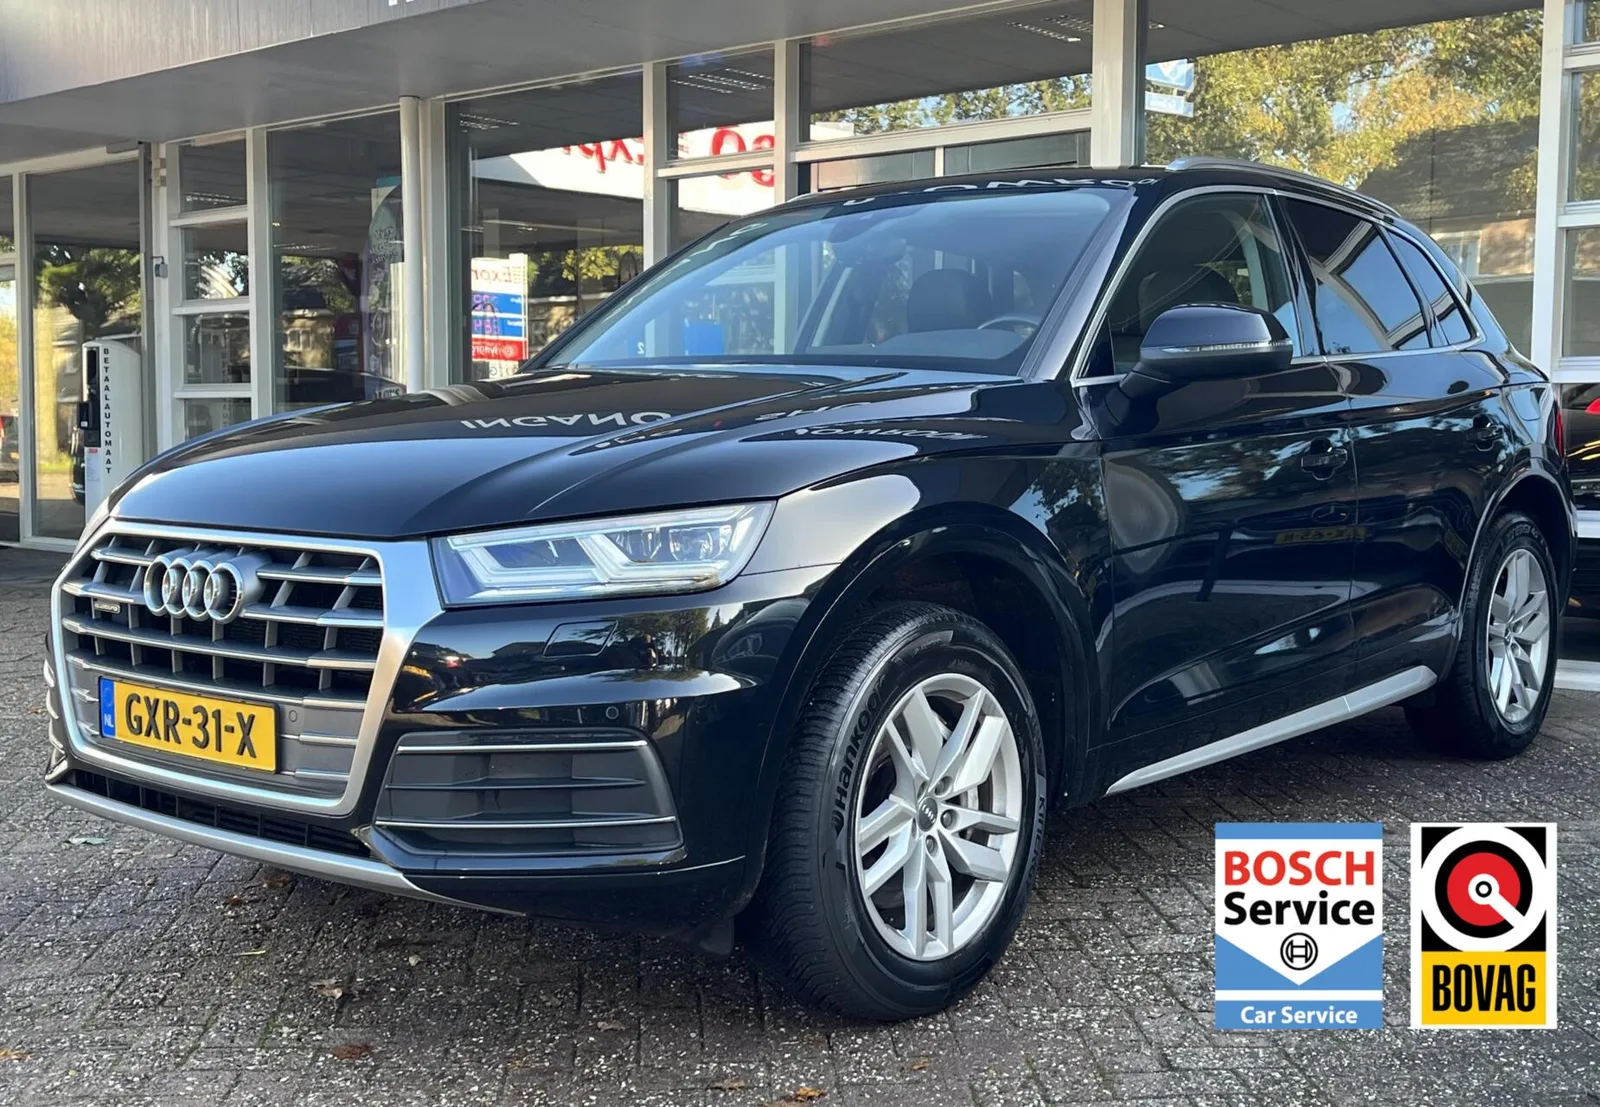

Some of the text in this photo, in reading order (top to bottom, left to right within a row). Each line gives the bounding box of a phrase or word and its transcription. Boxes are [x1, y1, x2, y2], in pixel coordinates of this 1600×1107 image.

[103, 348, 112, 474] BETAALAUTOMAAT
[103, 693, 257, 758] NL GXR-31-X
